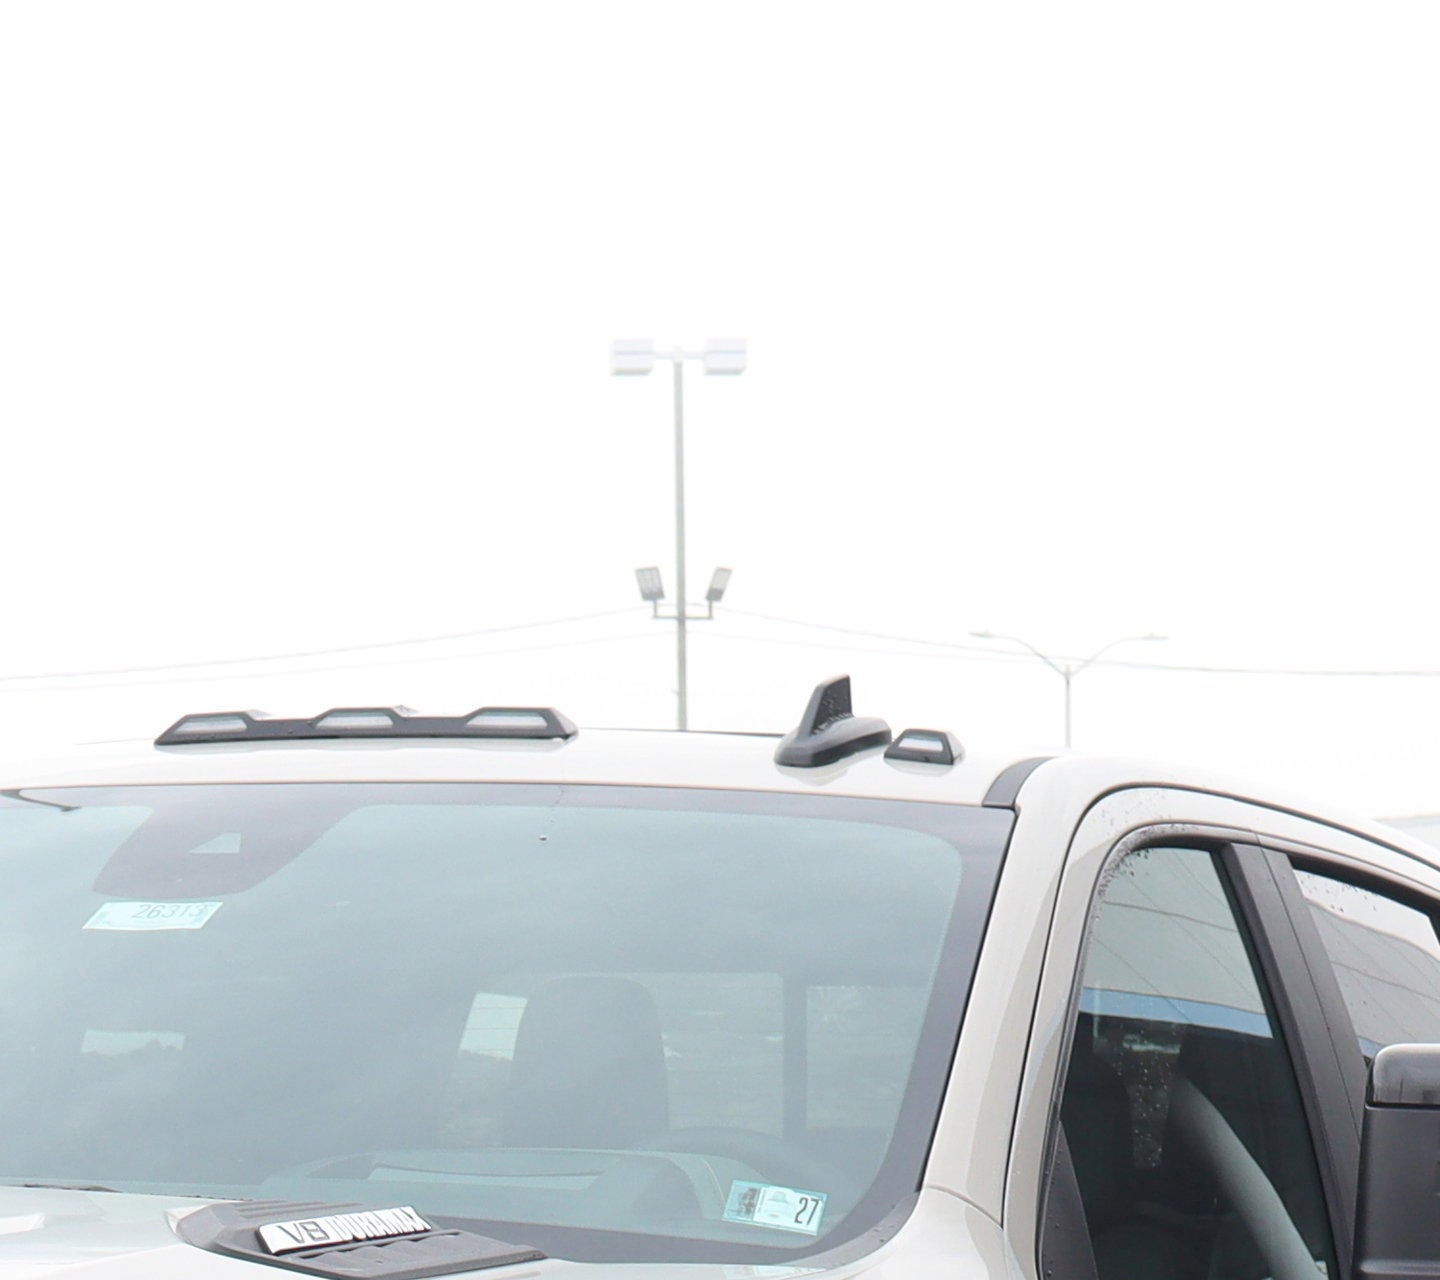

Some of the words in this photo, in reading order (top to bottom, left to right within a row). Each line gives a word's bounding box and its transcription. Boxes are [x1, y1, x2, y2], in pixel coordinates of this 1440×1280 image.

[277, 1220, 331, 1244] V8
[327, 1205, 432, 1243] DURAMAX
[793, 1196, 822, 1226] 27
